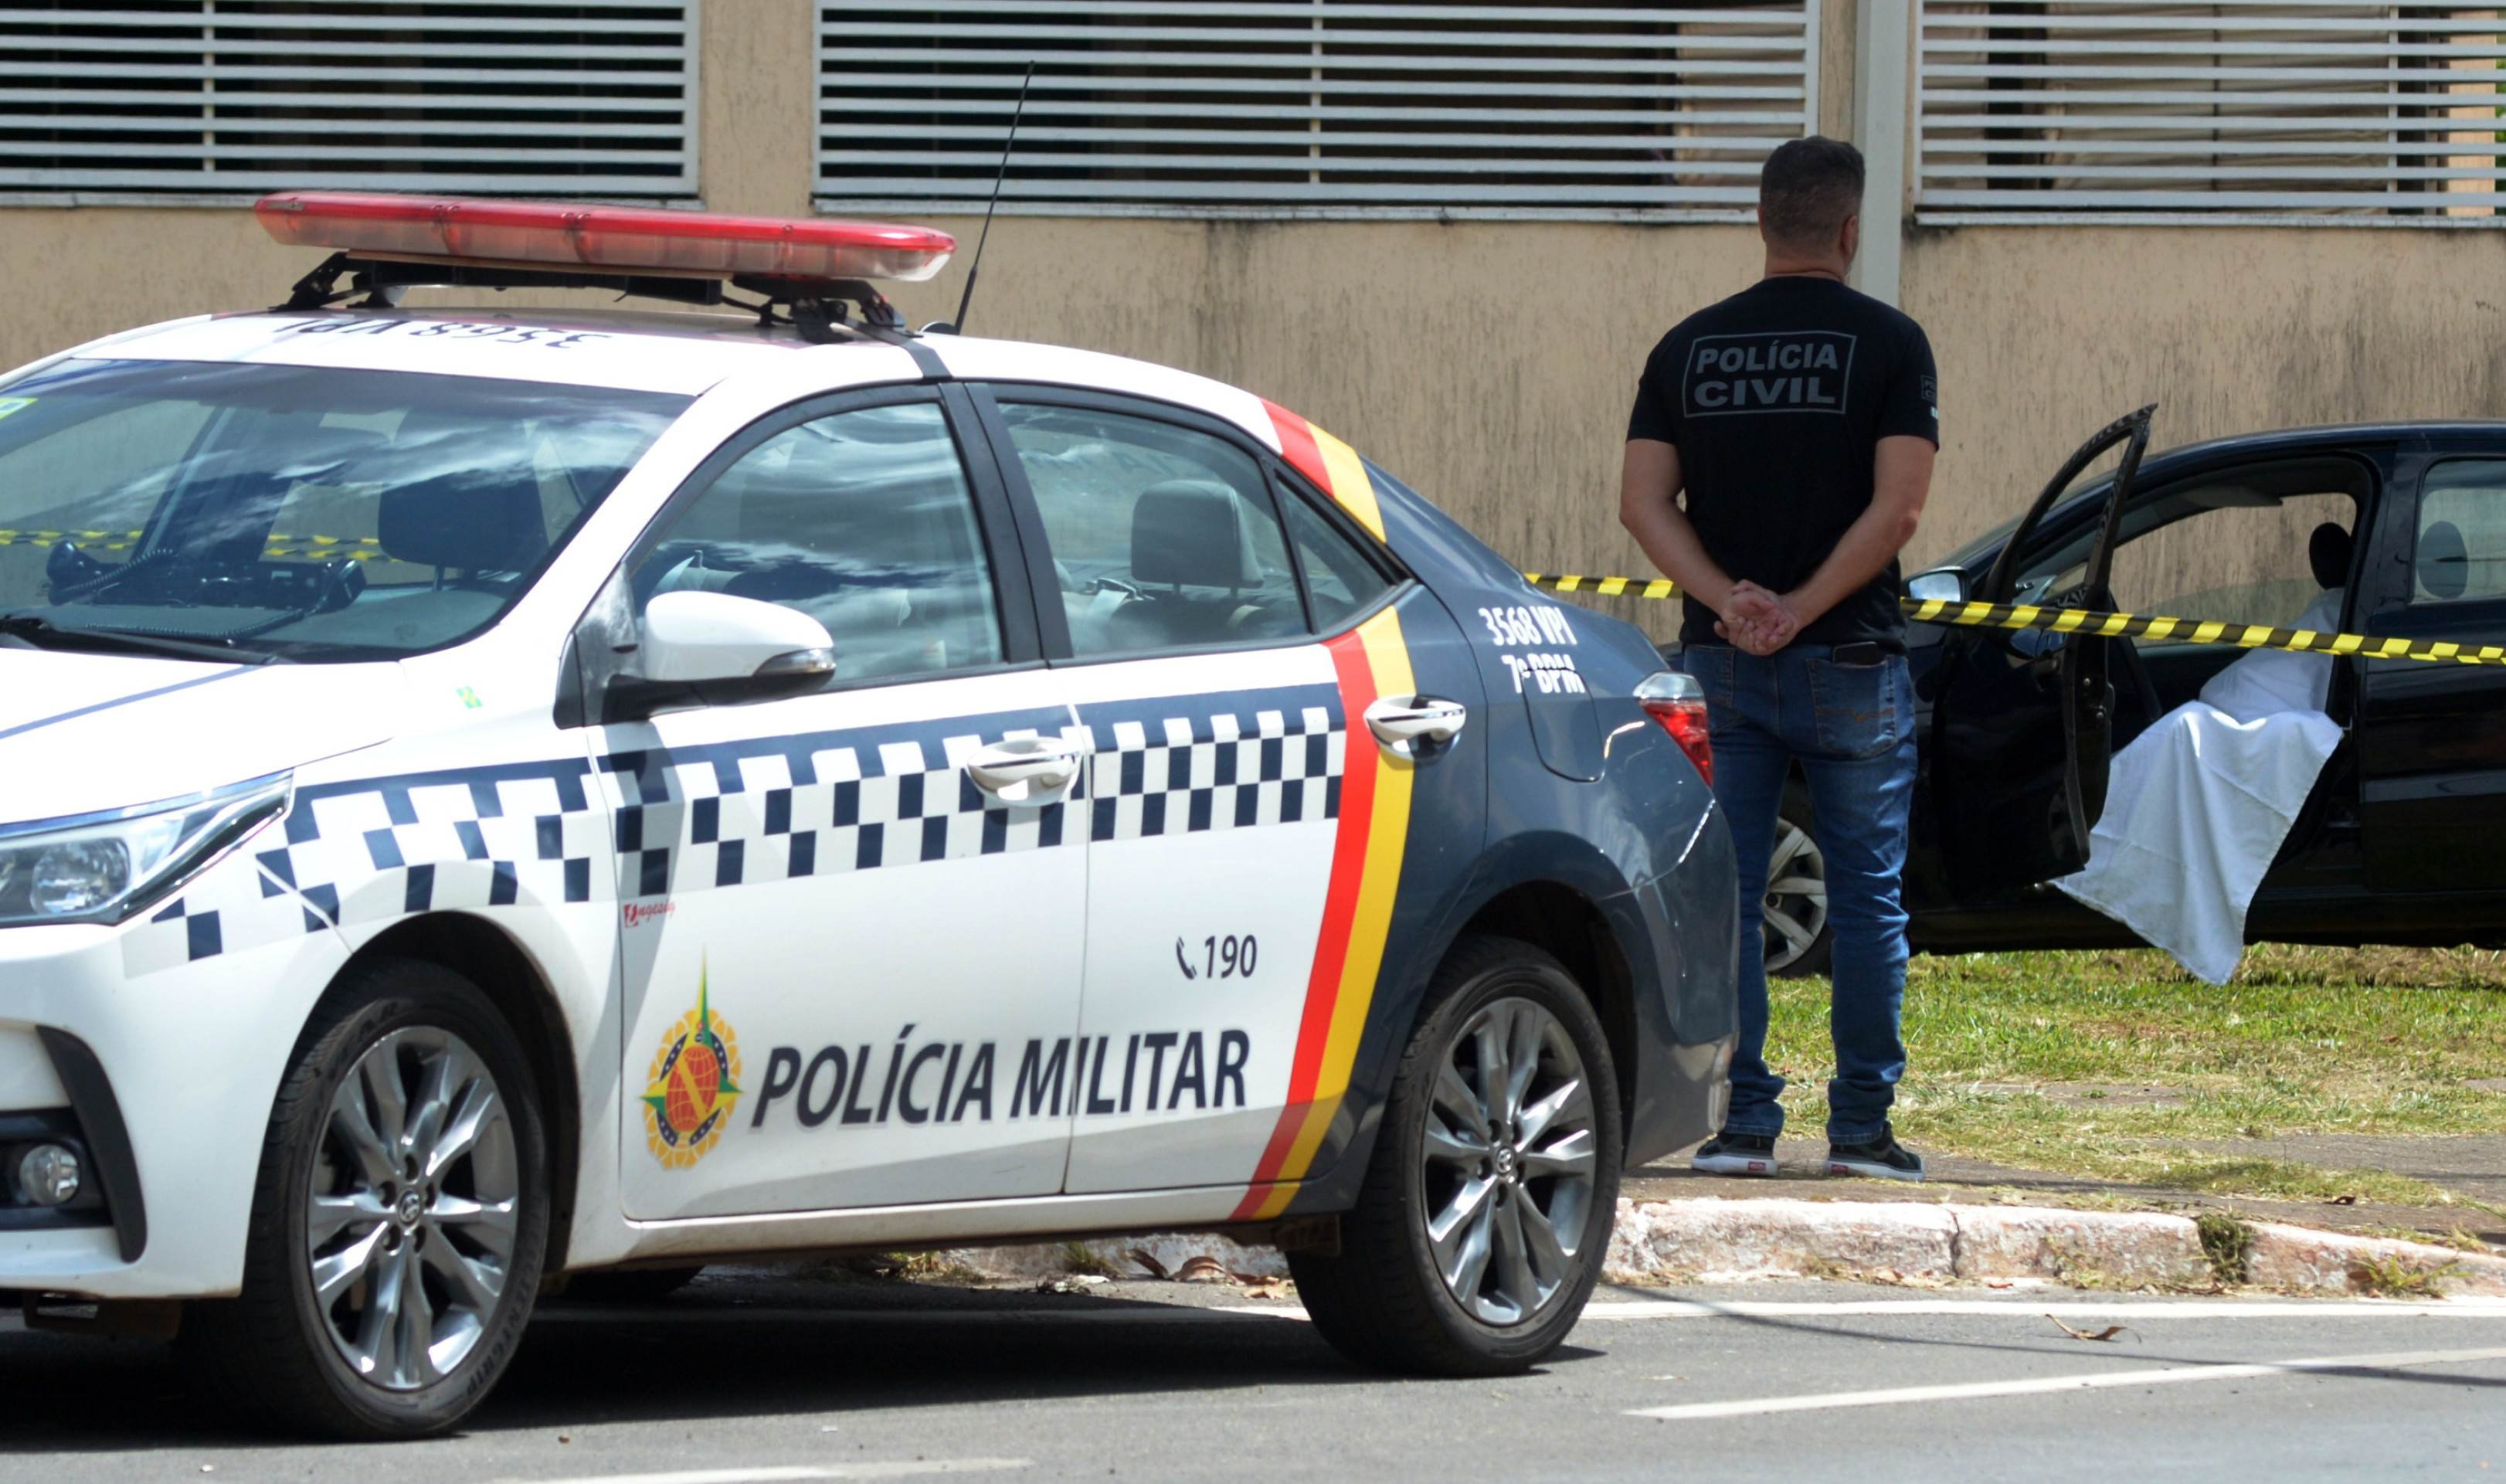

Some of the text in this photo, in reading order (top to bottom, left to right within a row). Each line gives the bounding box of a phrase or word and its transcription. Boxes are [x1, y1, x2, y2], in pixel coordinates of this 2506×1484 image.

[1696, 340, 1838, 374] POLÍCIA
[1694, 377, 1835, 407] CIVIL
[1205, 934, 1258, 979] 190
[751, 1023, 1251, 1128] POLÍCIA MILITAR
